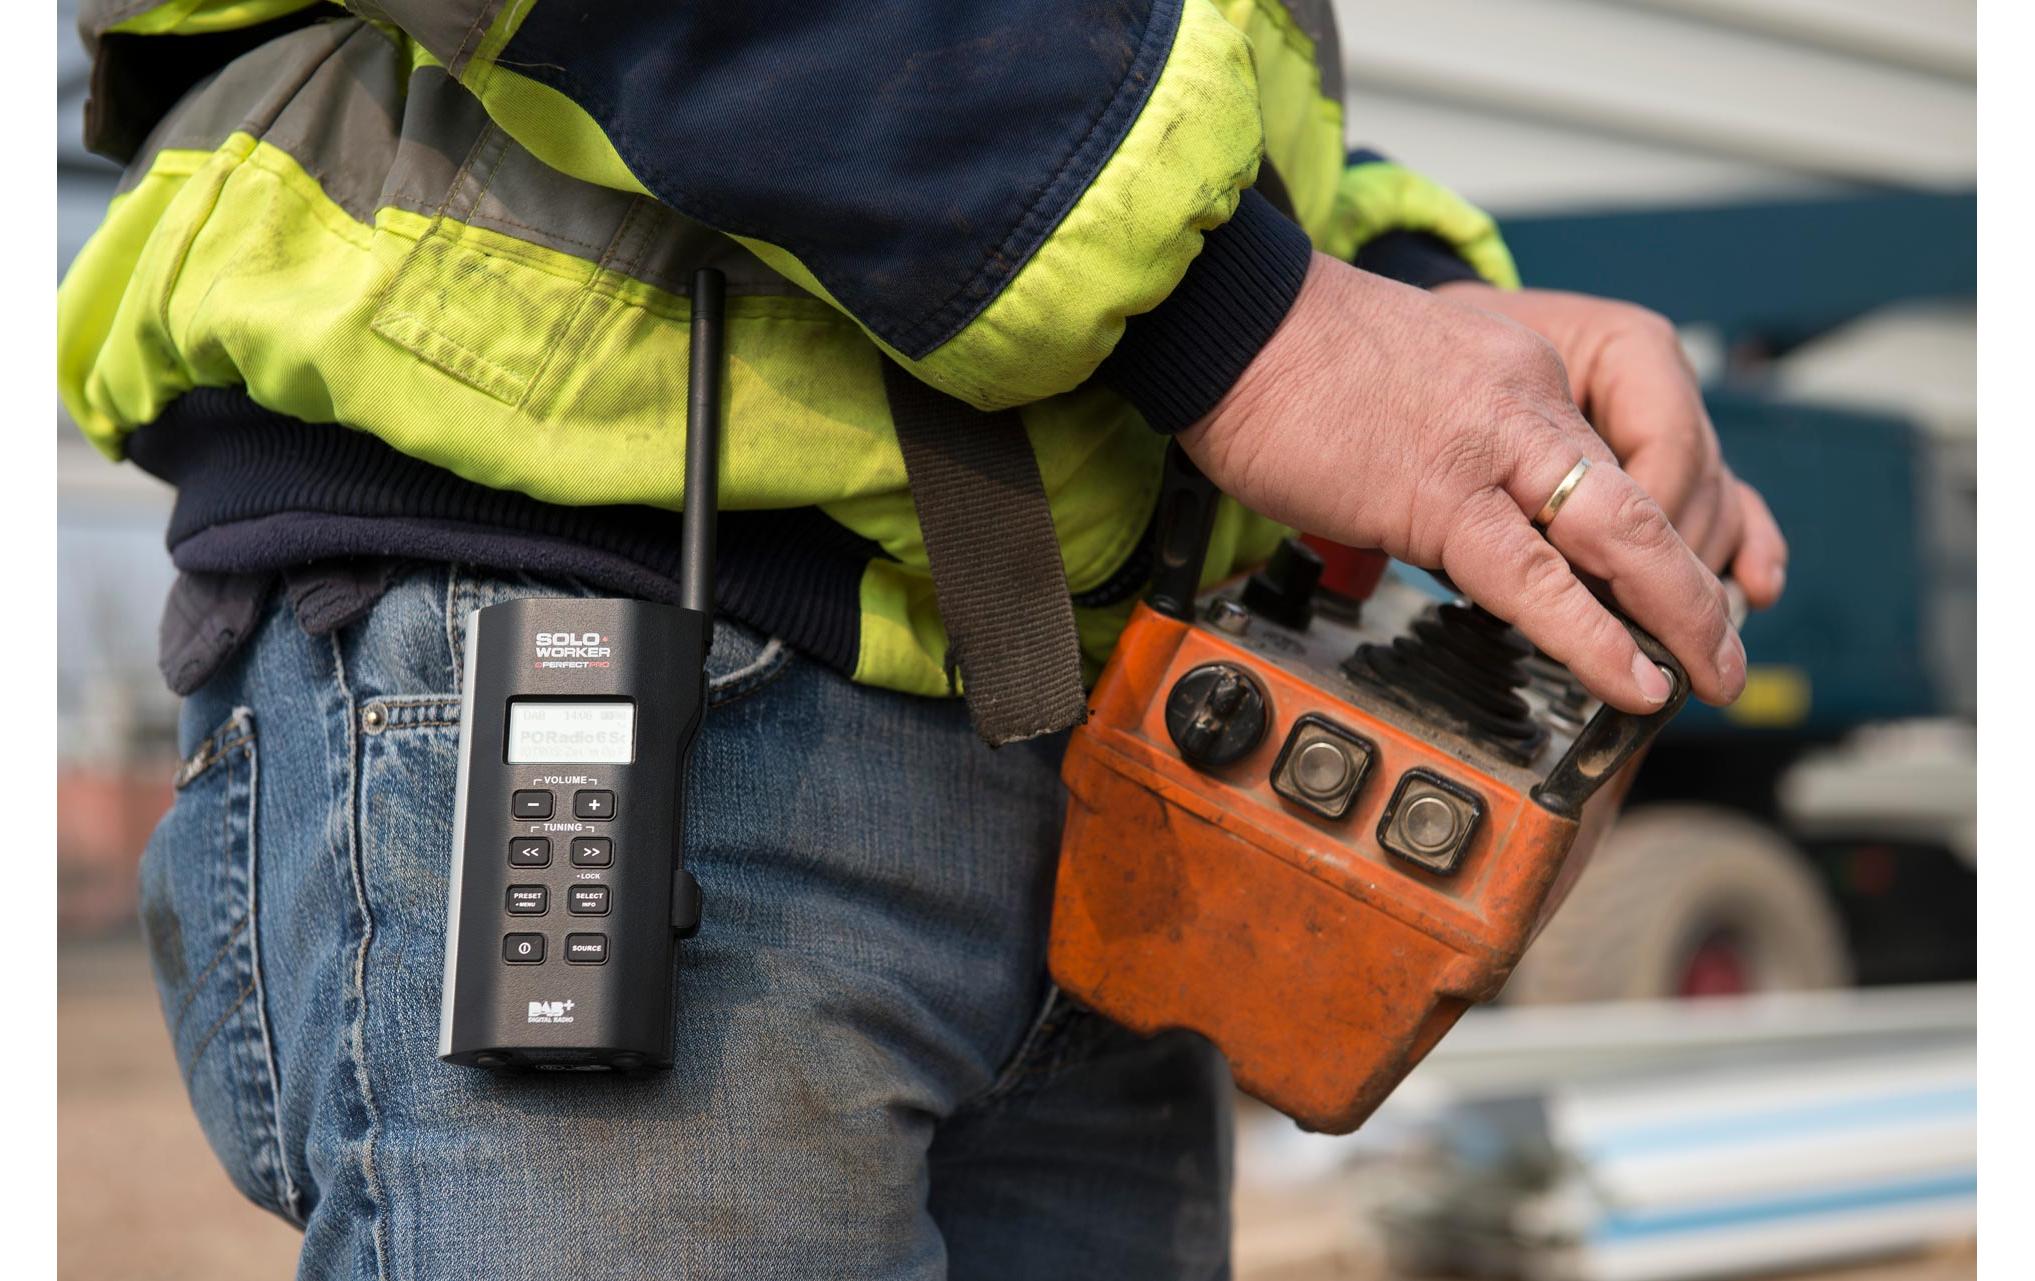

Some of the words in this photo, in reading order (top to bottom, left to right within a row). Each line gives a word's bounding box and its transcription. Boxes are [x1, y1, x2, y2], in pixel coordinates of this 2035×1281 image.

[536, 633, 600, 646] SOLO
[536, 647, 611, 658] WORKER
[544, 776, 587, 784] VOLUME
[544, 823, 583, 832] TUNING
